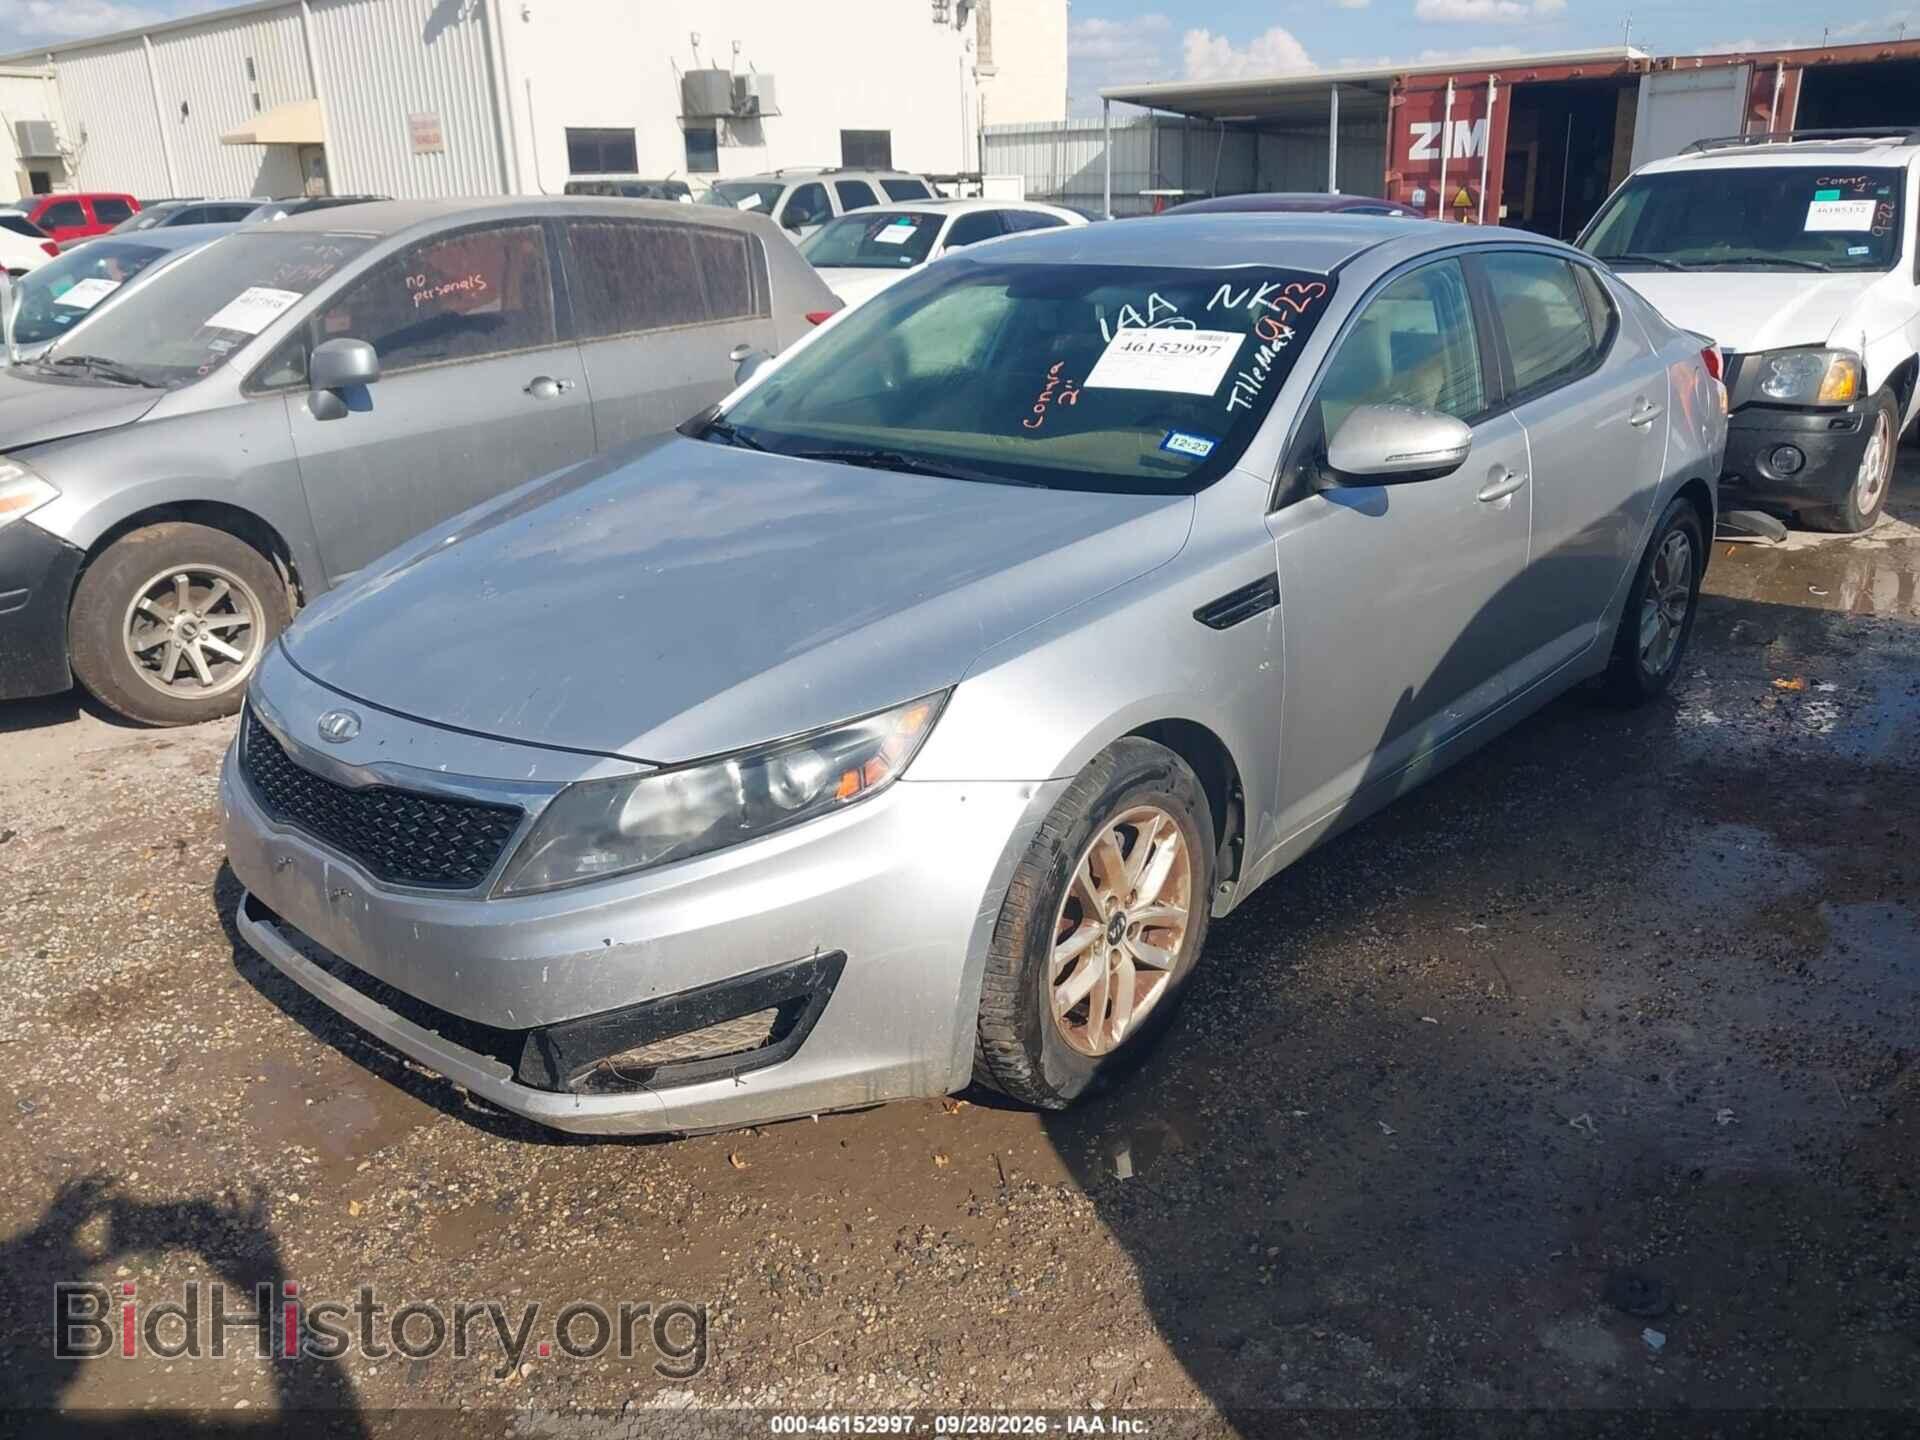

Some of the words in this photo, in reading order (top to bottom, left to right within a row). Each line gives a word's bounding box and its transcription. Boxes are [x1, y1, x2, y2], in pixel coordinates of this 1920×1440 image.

[1408, 118, 1487, 160] ZIM
[405, 274, 426, 289] no
[1100, 292, 1178, 343] IAA
[1206, 281, 1281, 312] NK
[1255, 282, 1327, 340] 9-23
[1119, 341, 1223, 357] 46152997
